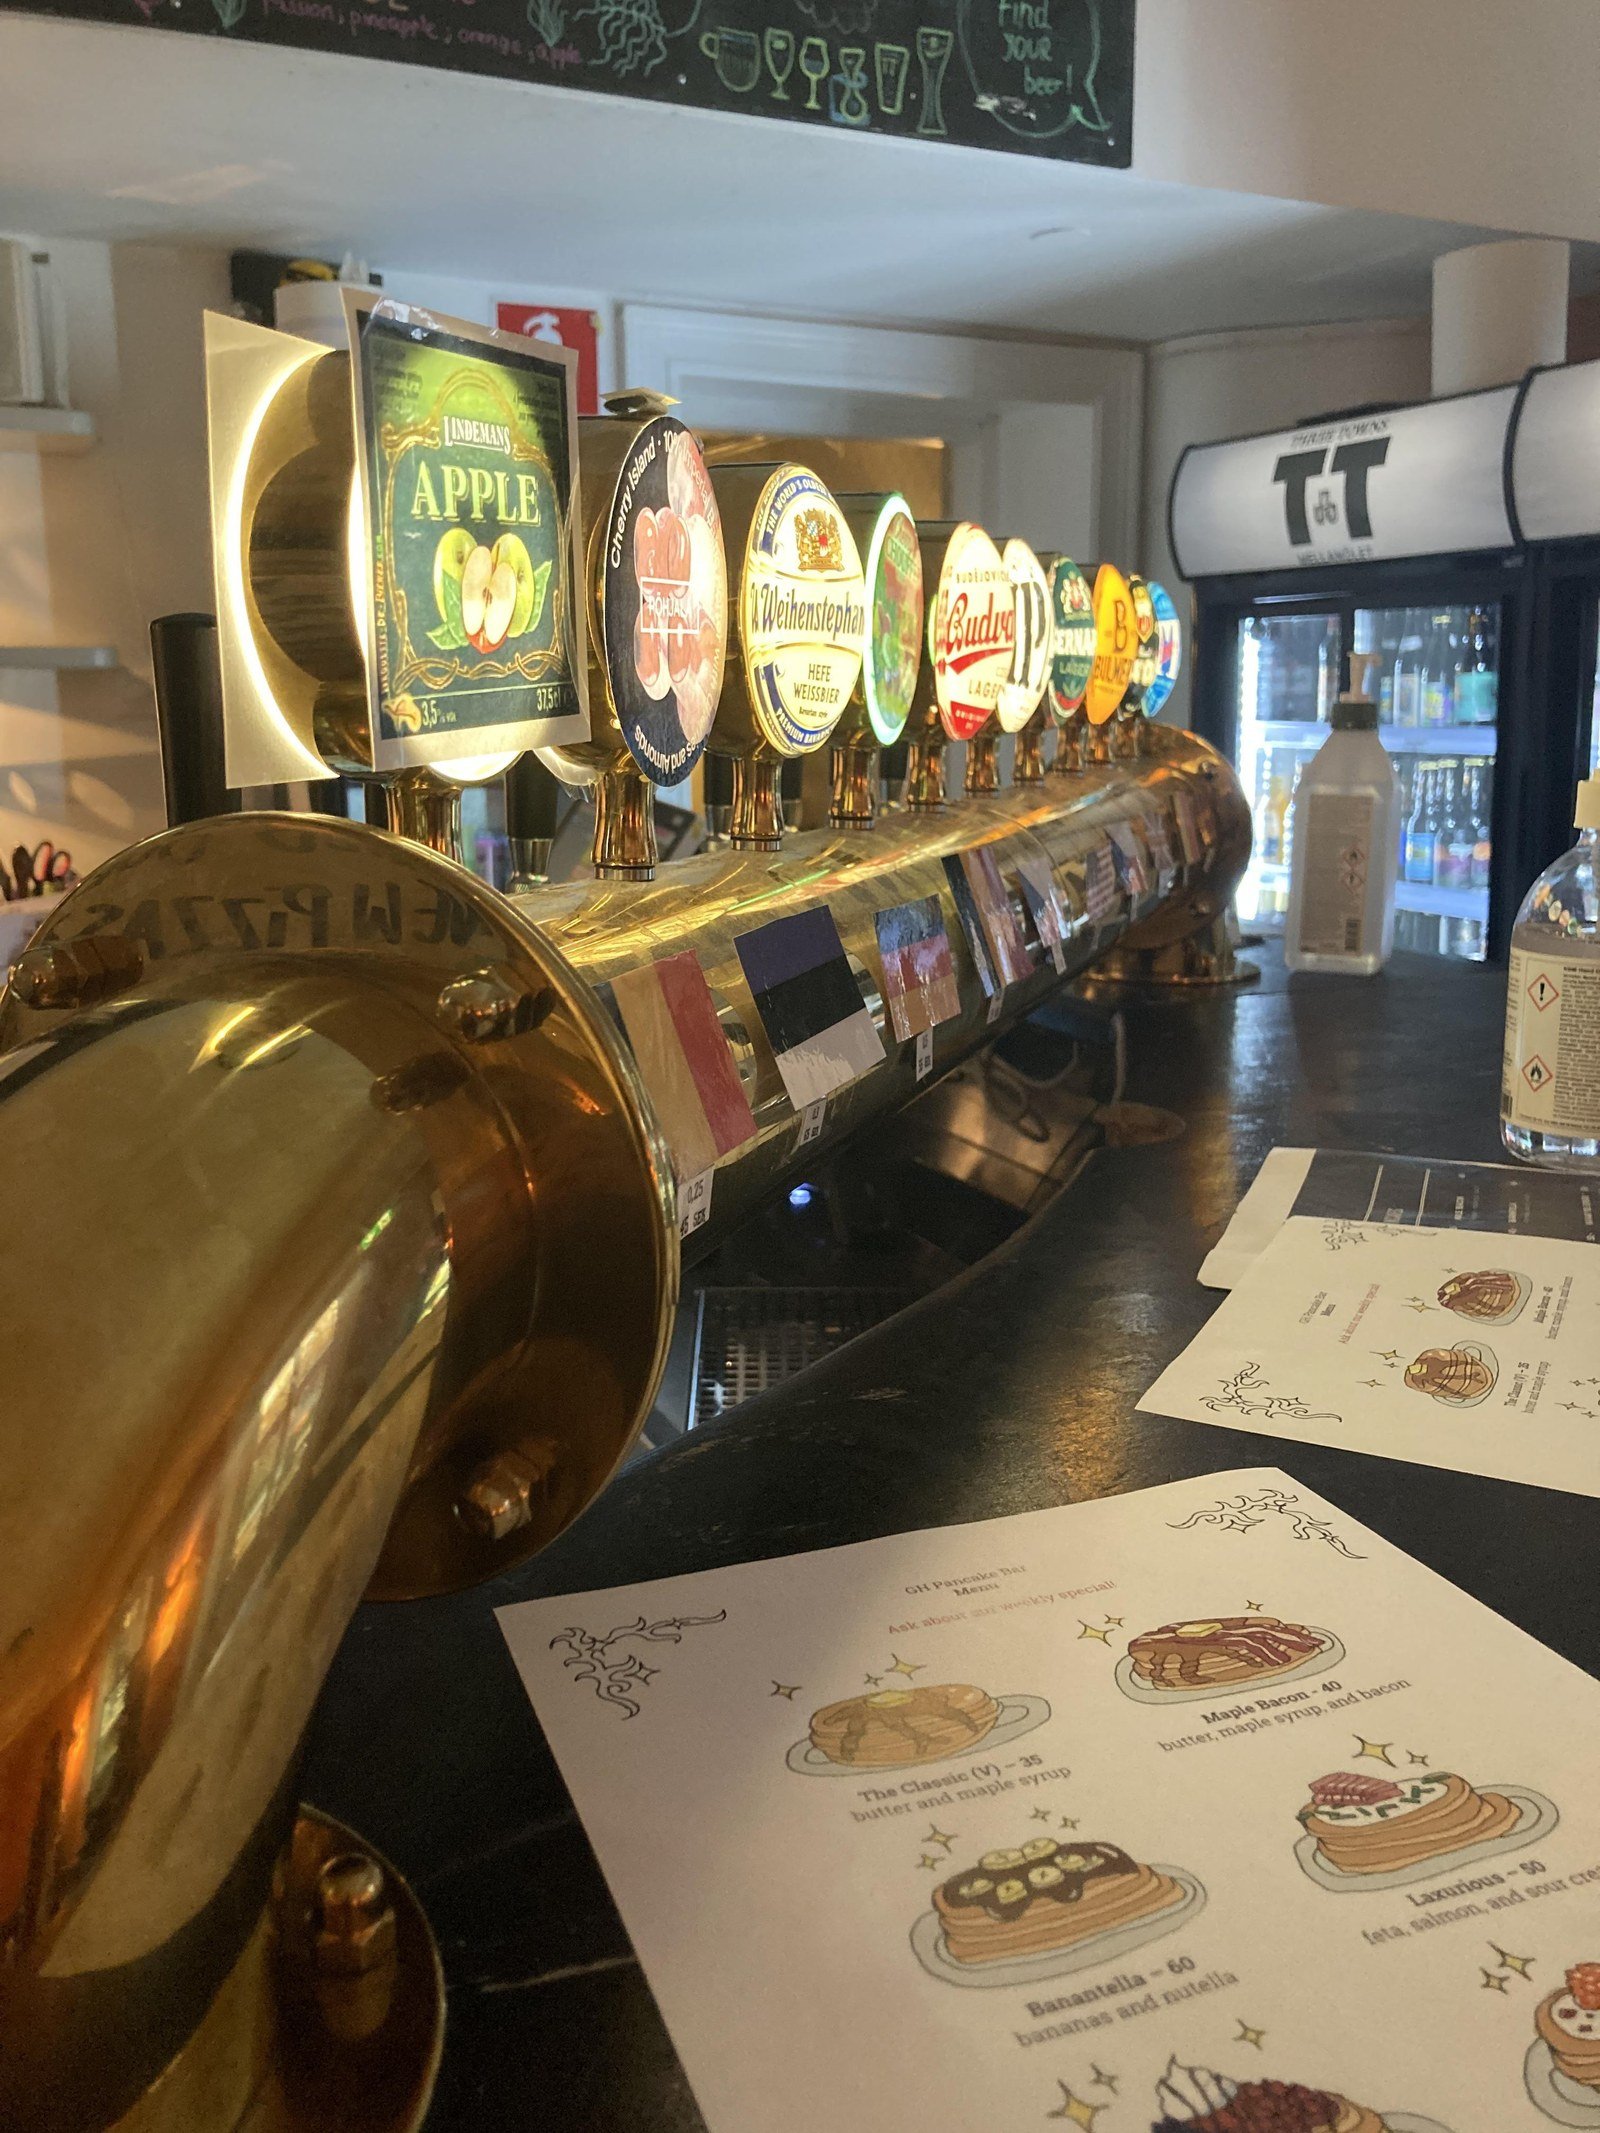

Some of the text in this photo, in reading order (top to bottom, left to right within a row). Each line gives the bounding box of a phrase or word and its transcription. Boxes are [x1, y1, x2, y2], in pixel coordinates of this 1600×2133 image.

[443, 416, 511, 455] LINDEMANS
[411, 460, 541, 527] APPLE
[611, 484, 633, 569] Cherry
[628, 436, 656, 491] Island
[766, 509, 779, 535] THE
[945, 592, 1015, 656] Budva
[794, 682, 840, 704] WEISSBIER
[808, 663, 831, 682] HEFE
[776, 707, 805, 743] PREMIUM
[635, 724, 669, 775] Almonds
[671, 751, 687, 774] and
[687, 1179, 704, 1204] 0,25
[693, 1207, 706, 1227] SEK
[905, 1565, 1027, 1595] GH Pancake Bar
[952, 1583, 1000, 1597] Menu
[888, 1621, 921, 1635] Ask
[921, 1612, 966, 1627] about
[999, 1593, 1054, 1611] weekly
[1157, 1678, 1412, 1752] butter, maple syrup, and bacon
[1200, 1703, 1256, 1725] Maple
[1257, 1689, 1311, 1711] Bacon
[1321, 1680, 1343, 1693] 40
[850, 1765, 1072, 1823] butter and maple syrup
[857, 1788, 898, 1803] The
[900, 1771, 969, 1795] Classic
[971, 1763, 1001, 1781] (V)
[1019, 1754, 1043, 1768] 35
[1519, 1859, 1547, 1875] 50
[1361, 1924, 1412, 1945] feta,
[1409, 1902, 1490, 1932] salmon,
[1485, 1888, 1527, 1911] and
[1524, 1878, 1570, 1899] sour
[1025, 1973, 1147, 2018] Banantella
[1167, 1956, 1196, 1974] 60
[1013, 1970, 1240, 2048] bananas and nutella
